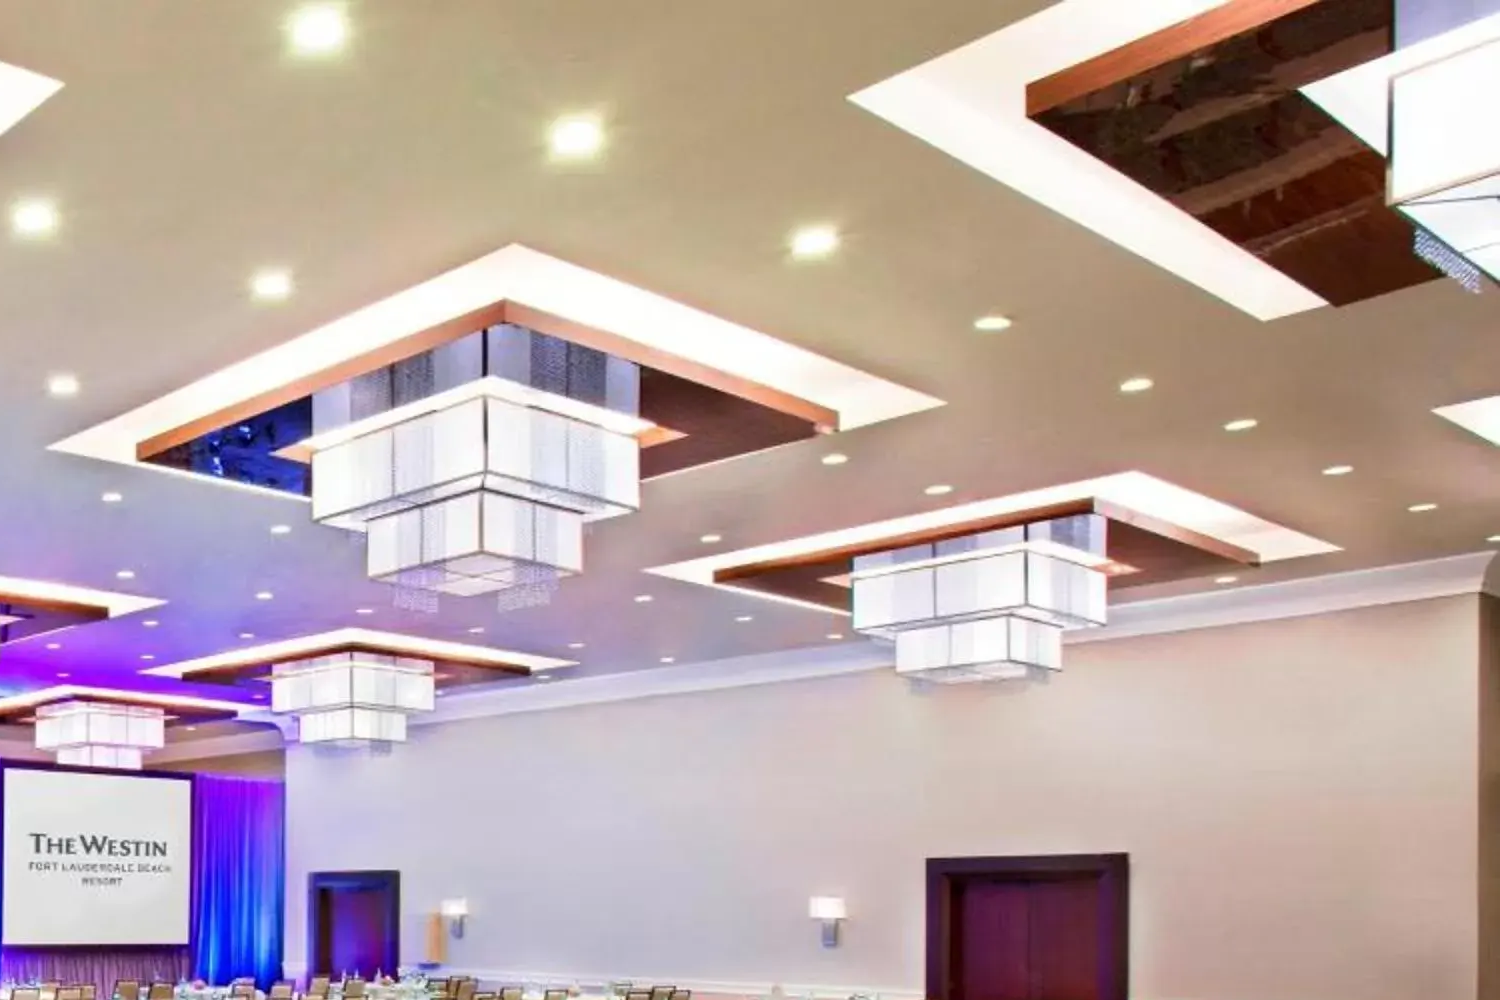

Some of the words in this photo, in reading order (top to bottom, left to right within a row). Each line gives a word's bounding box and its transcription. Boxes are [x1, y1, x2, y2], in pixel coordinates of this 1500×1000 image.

[28, 832, 77, 855] THE
[79, 834, 167, 857] WESTIN
[28, 862, 58, 872] FORT
